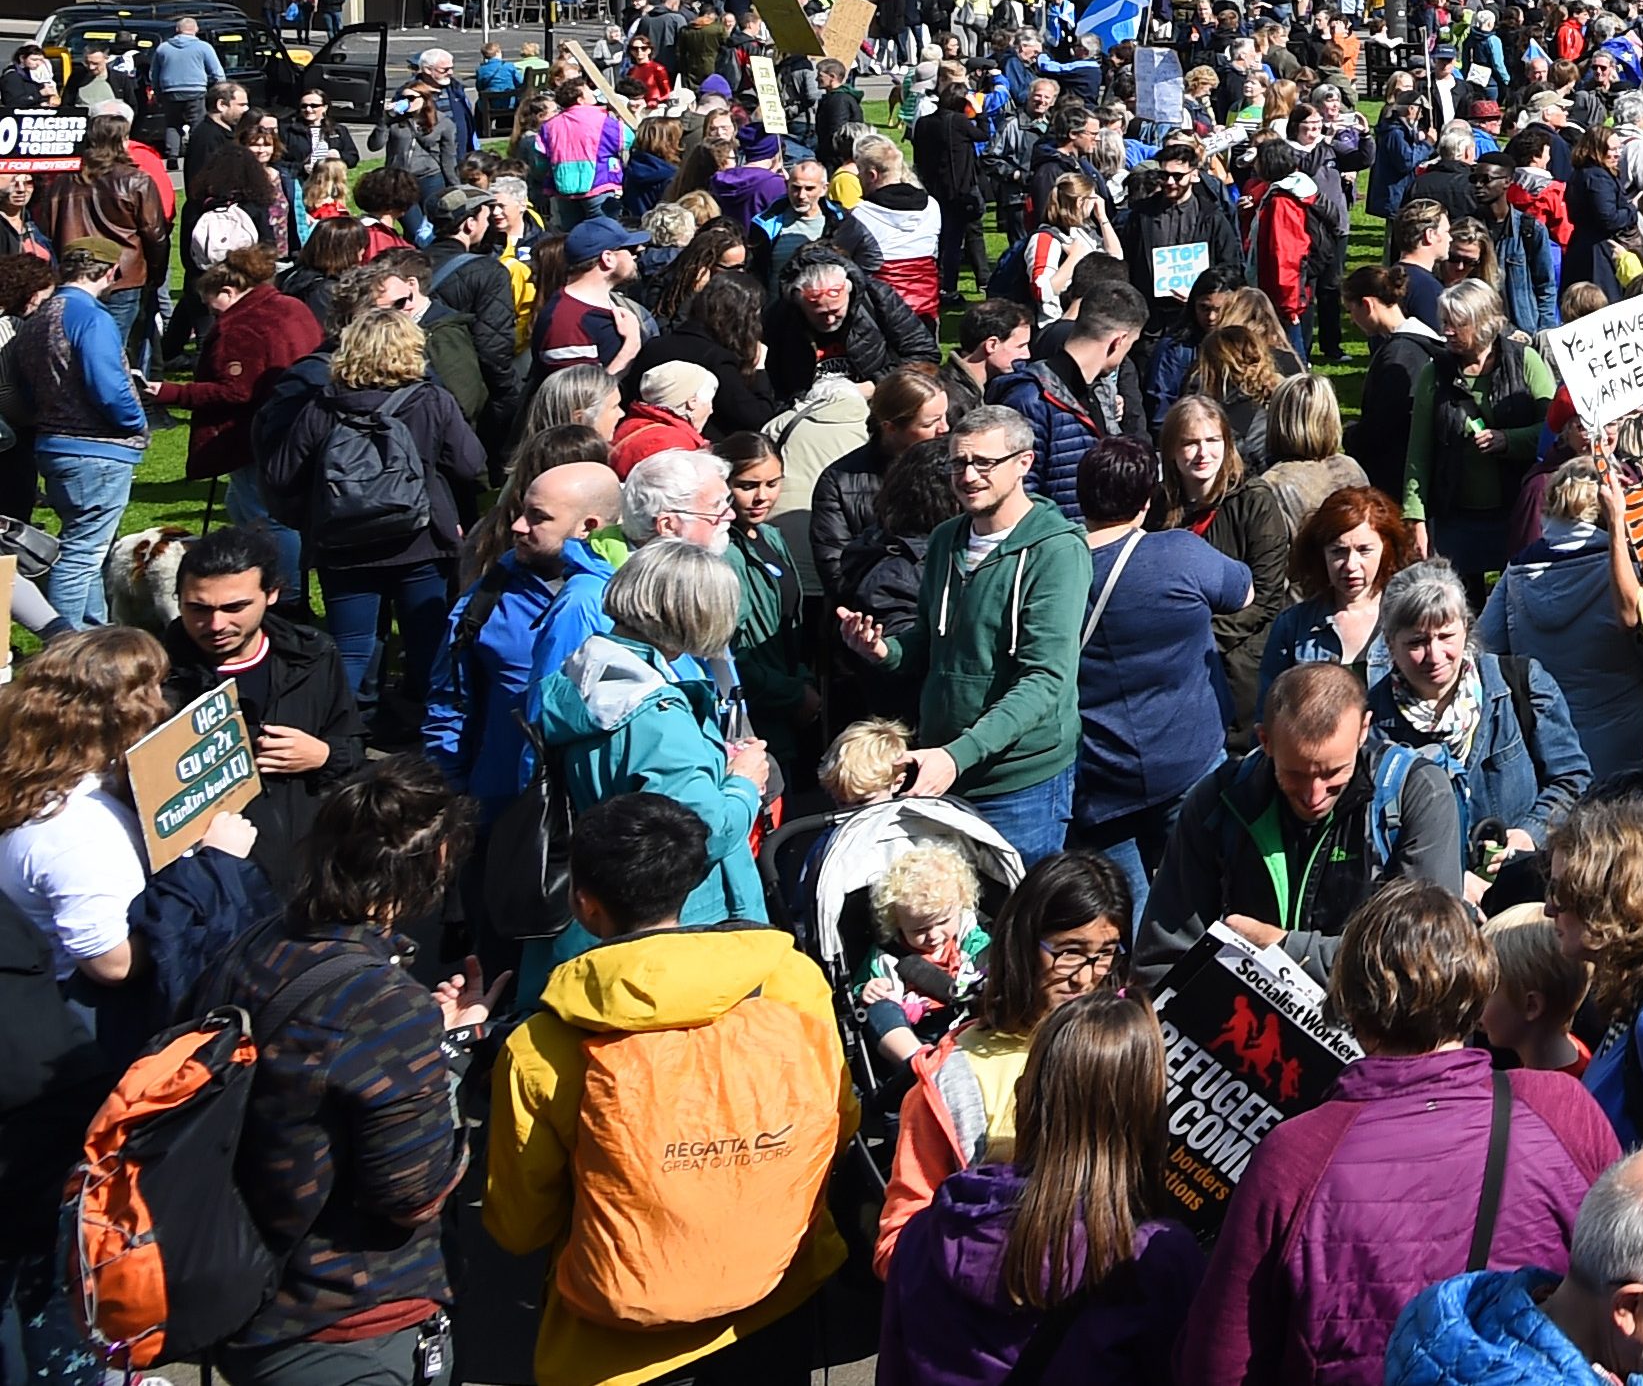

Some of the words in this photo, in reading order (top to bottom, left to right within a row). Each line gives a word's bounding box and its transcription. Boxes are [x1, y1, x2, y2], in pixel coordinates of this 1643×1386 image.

[20, 129, 87, 142] TRIDENT
[18, 141, 75, 155] TORIES
[1155, 244, 1207, 265] STOP
[1168, 262, 1194, 275] THE
[1155, 273, 1197, 291] COU
[178, 753, 203, 780] EU
[230, 750, 249, 779] EU
[1161, 1020, 1285, 1145] REFUGEE
[664, 1137, 750, 1159] REGATTA
[661, 1157, 707, 1174] GREAT
[709, 1147, 793, 1169] OUTDOORS
[1169, 1144, 1231, 1202] borders
